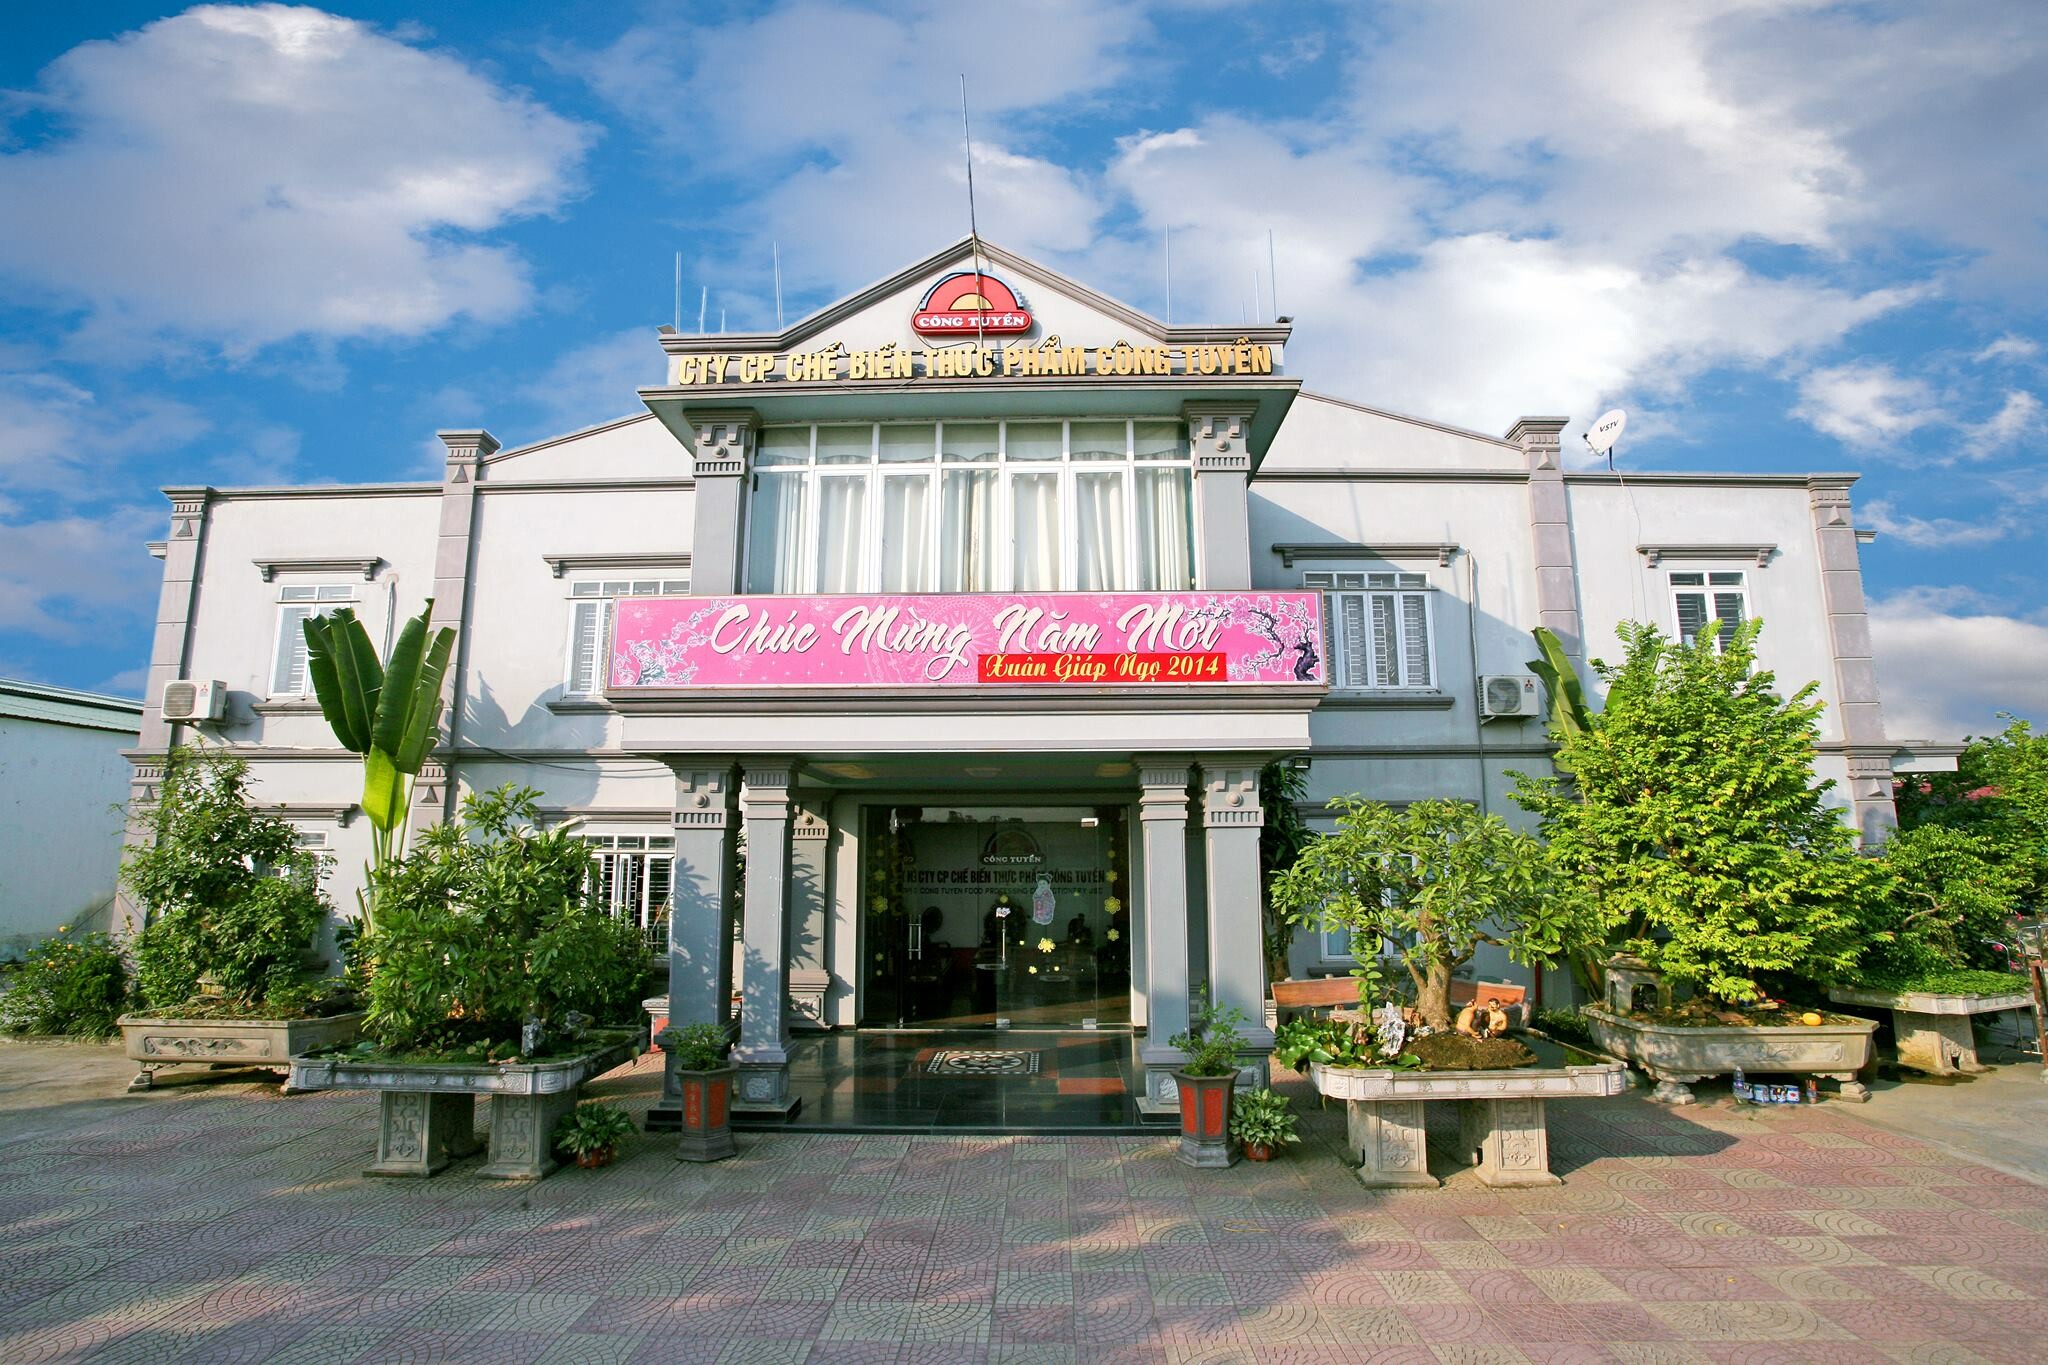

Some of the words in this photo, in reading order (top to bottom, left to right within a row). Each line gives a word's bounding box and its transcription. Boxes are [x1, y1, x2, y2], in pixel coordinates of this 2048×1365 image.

[918, 315, 964, 327] CÔNG
[679, 356, 730, 385] CTY
[739, 355, 775, 383] CP
[785, 341, 842, 382] CHẾ
[850, 341, 913, 380] BIẾN
[1003, 335, 1086, 376] PHẨM
[1096, 340, 1171, 376] CÔNG
[710, 603, 820, 654] Chúc
[832, 604, 973, 681] Mừng
[992, 602, 1102, 654] Năm
[984, 654, 1047, 678] Xuân
[1052, 654, 1108, 682] Giáp
[1114, 654, 1162, 682] Ngọ
[1168, 655, 1219, 677] 2014
[918, 870, 935, 883] CTY
[937, 870, 949, 883] CP
